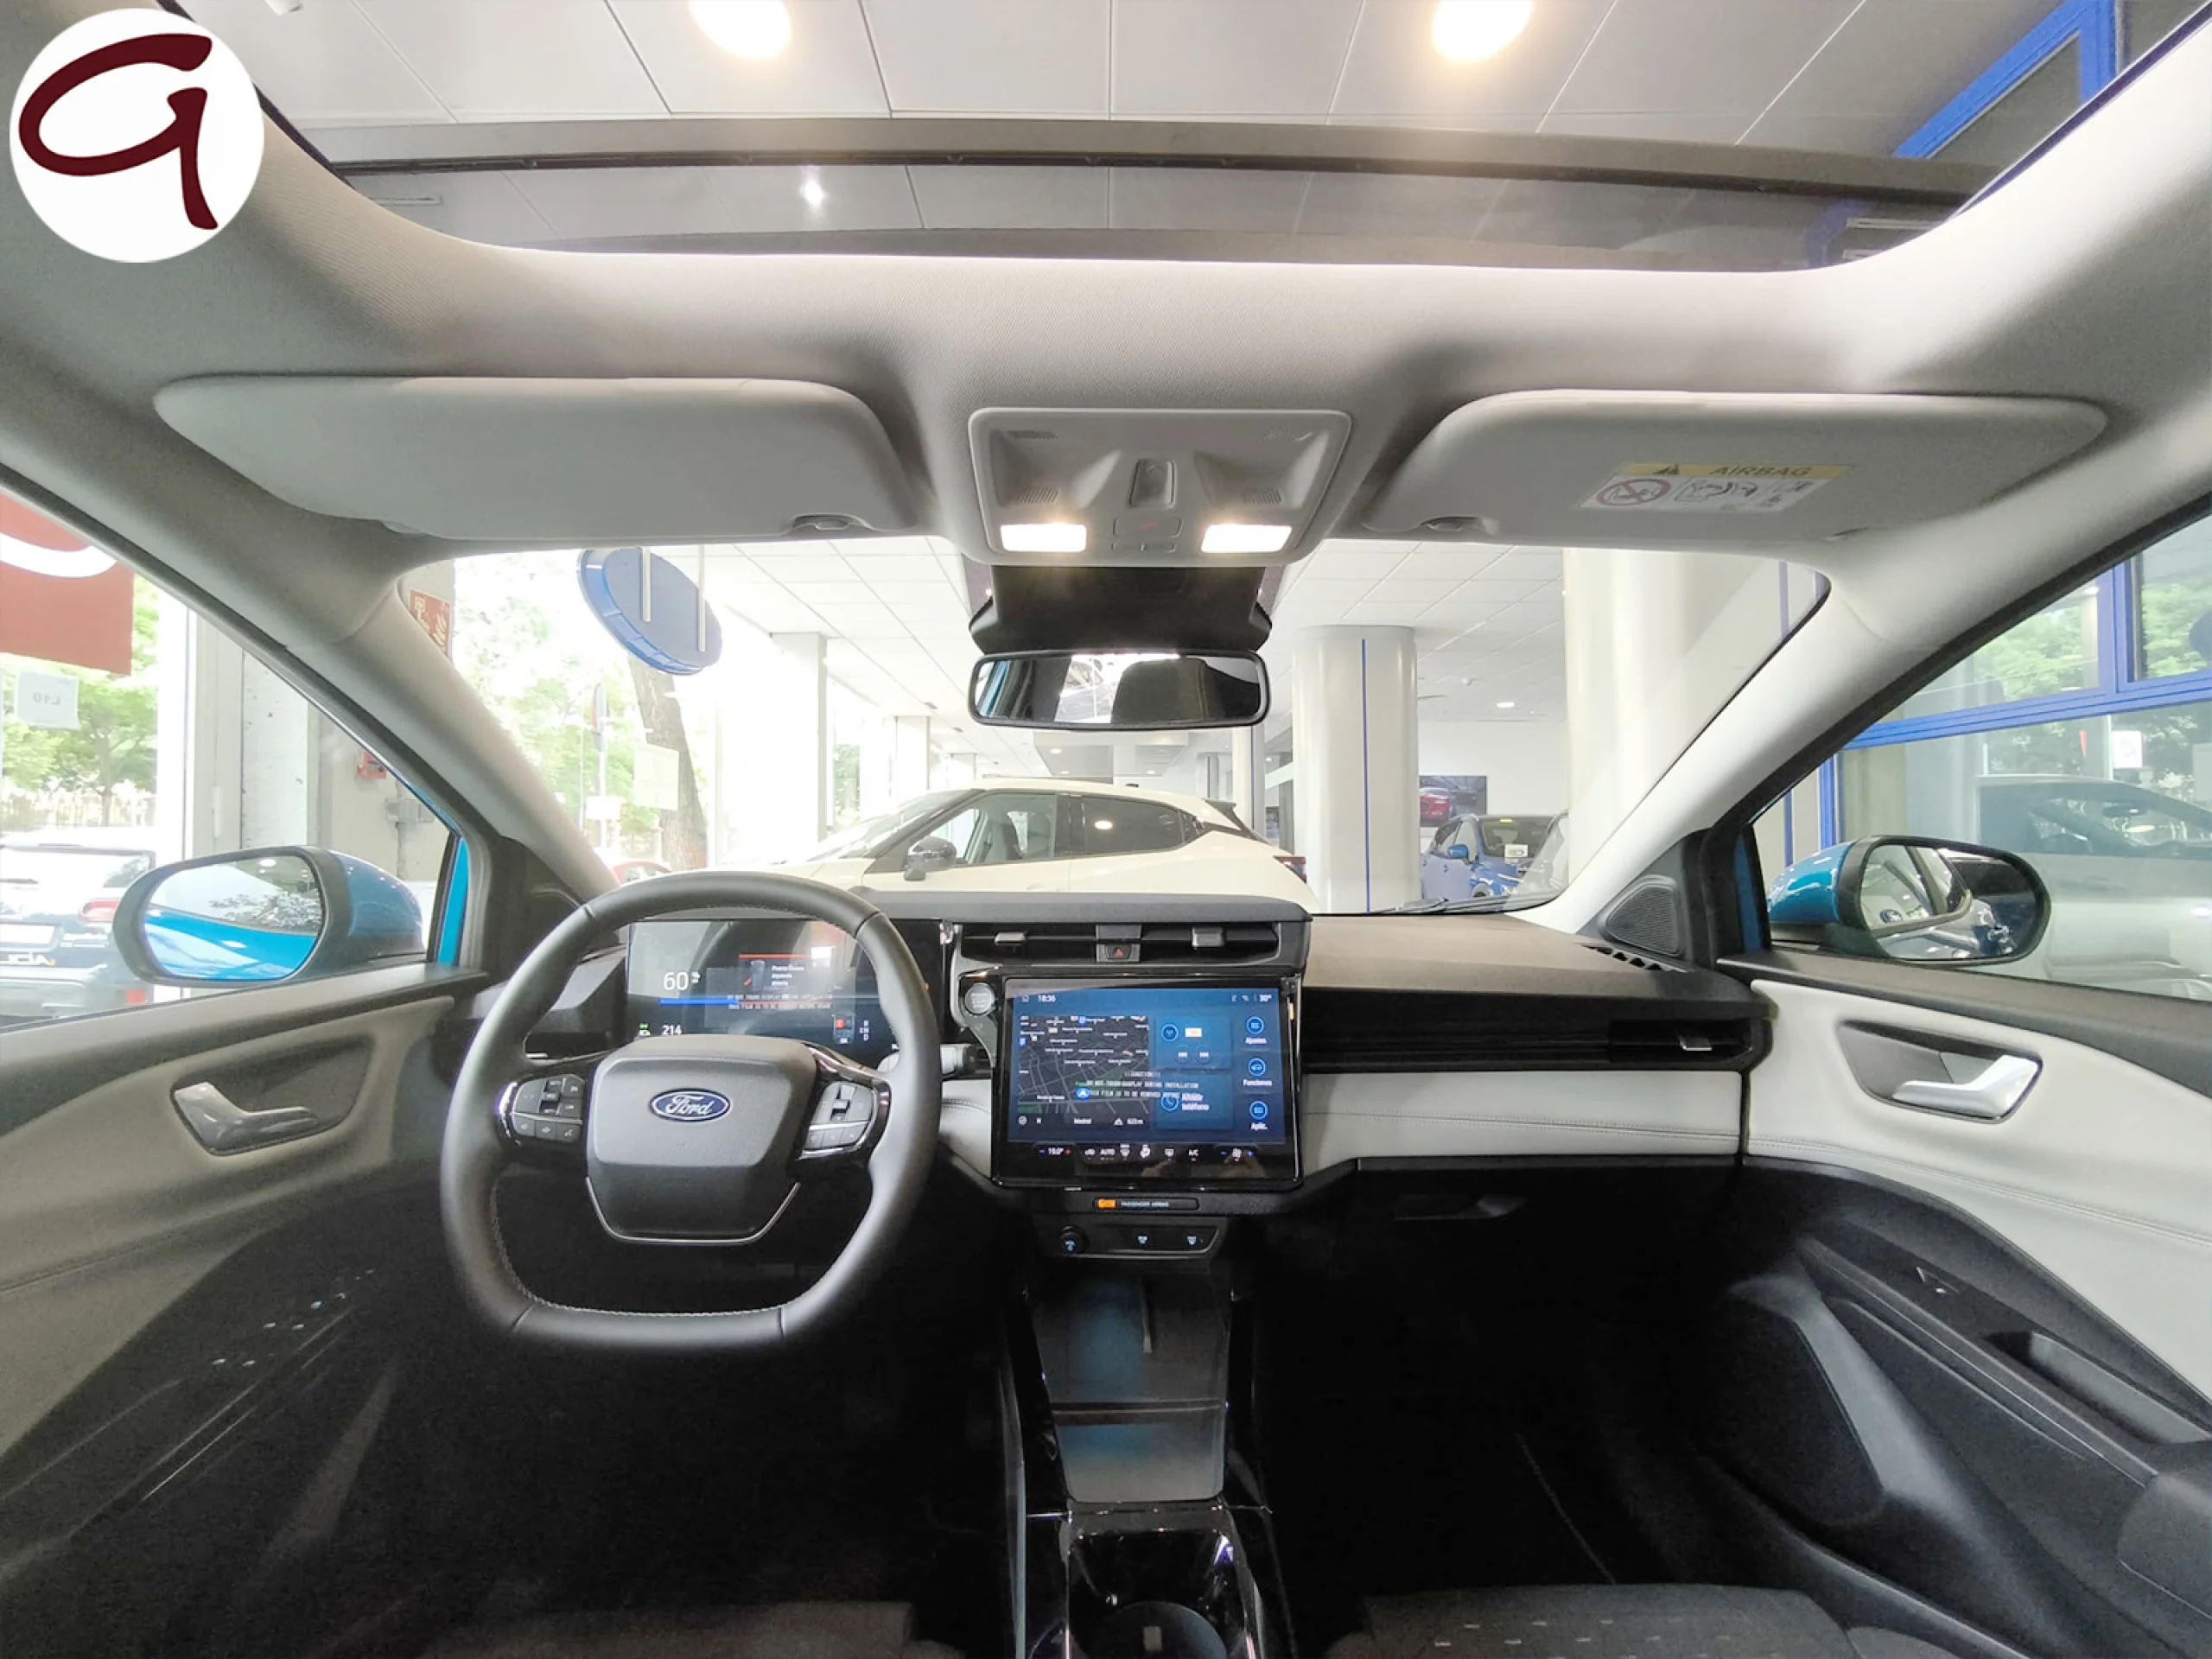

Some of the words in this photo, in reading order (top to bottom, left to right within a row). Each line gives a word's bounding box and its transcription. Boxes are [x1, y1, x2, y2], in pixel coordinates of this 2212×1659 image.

[1710, 466, 1812, 476] AIRBAG
[664, 971, 688, 990] 60
[663, 1024, 683, 1035] 214
[666, 1094, 715, 1116] Ford
